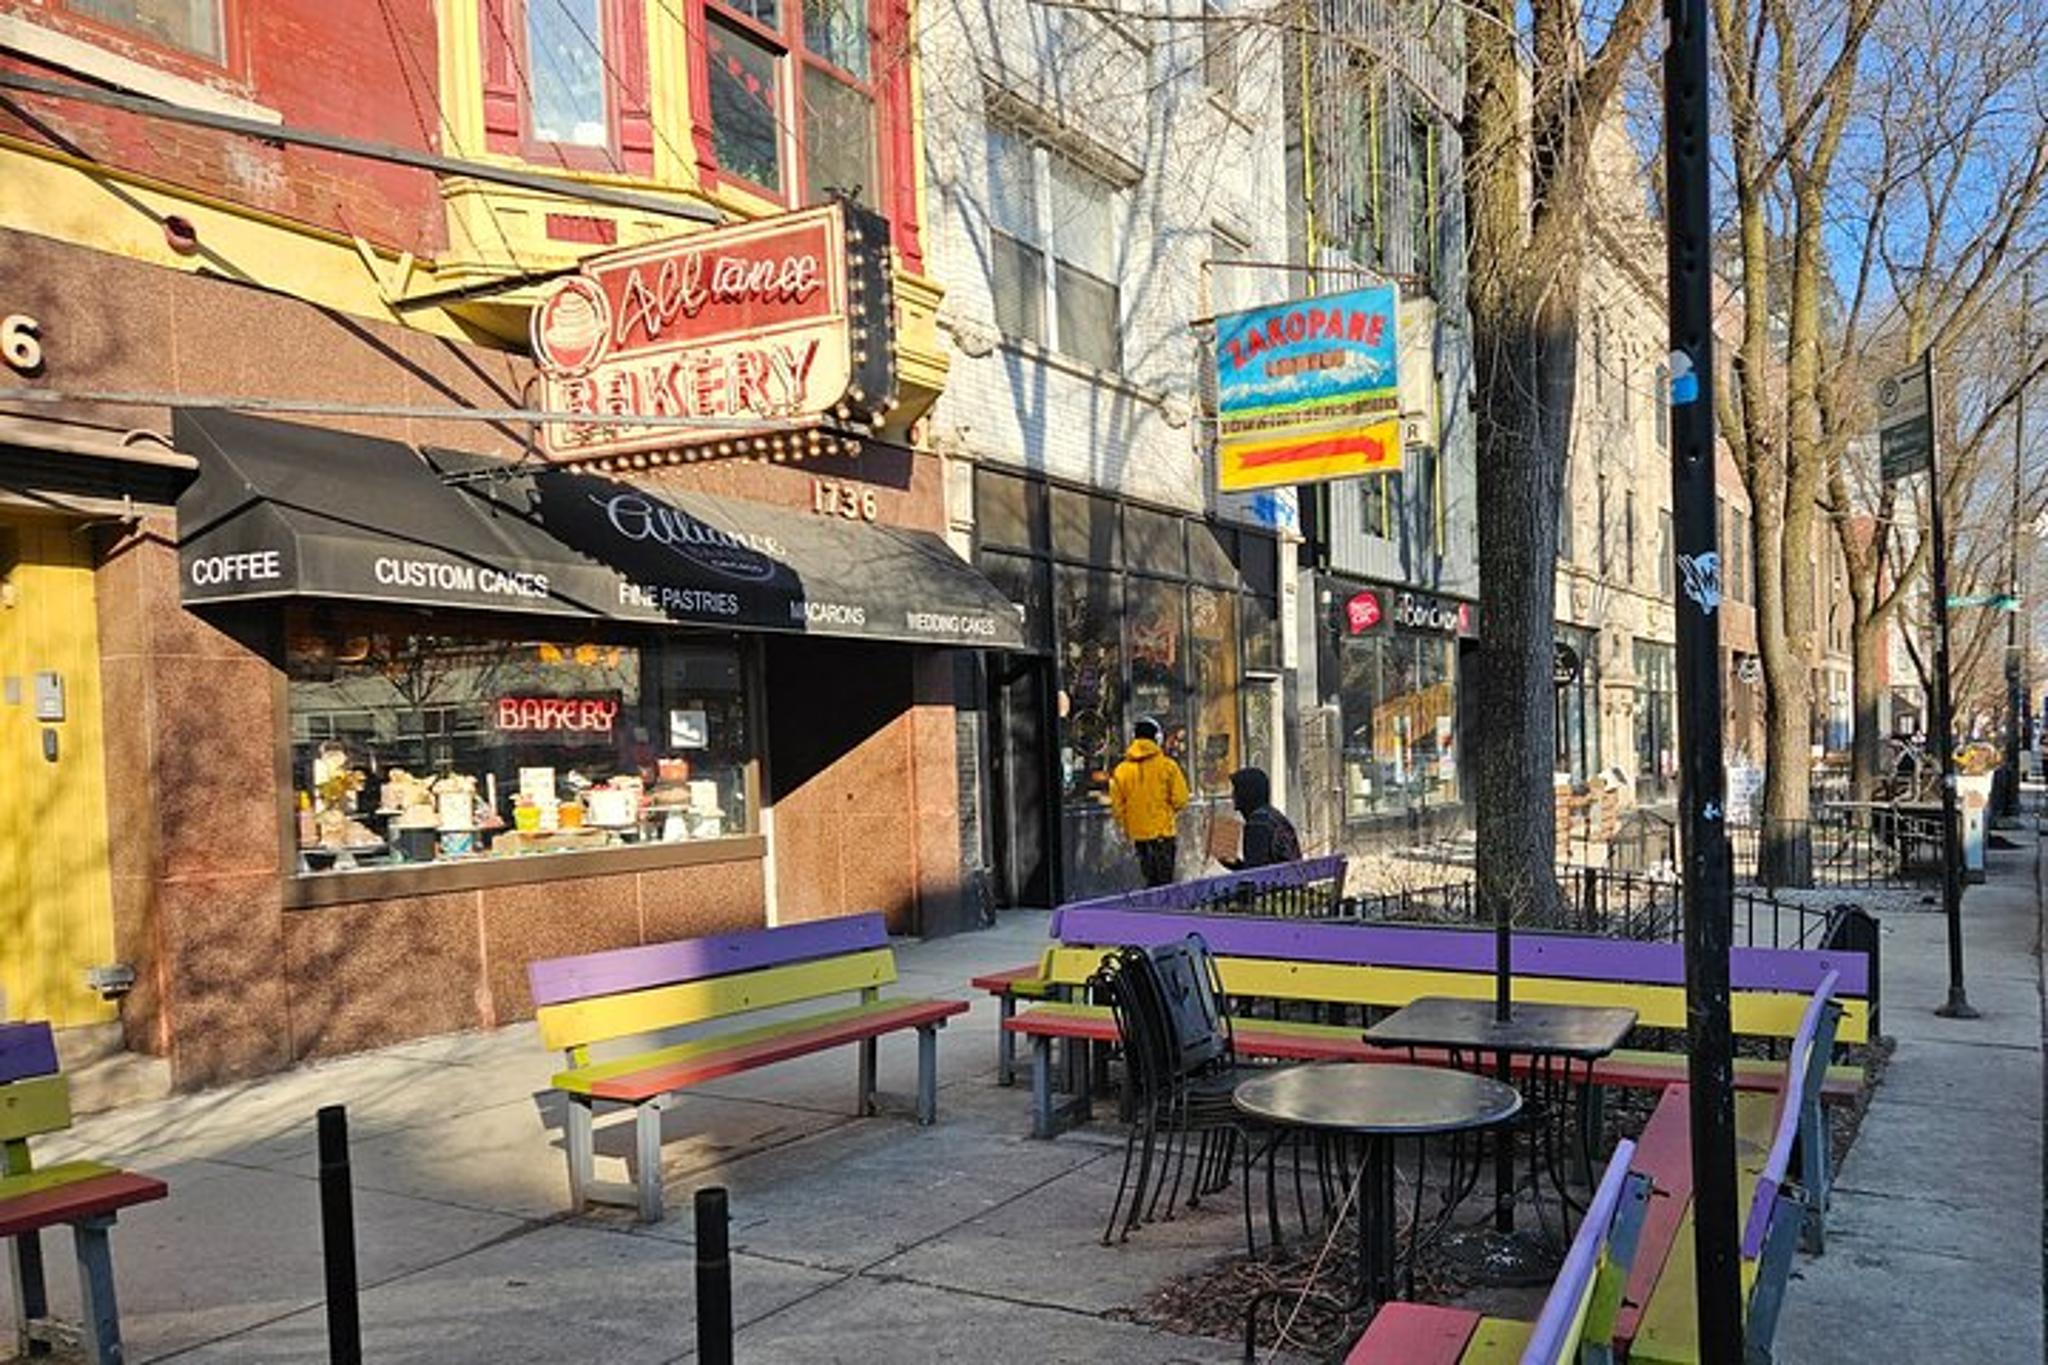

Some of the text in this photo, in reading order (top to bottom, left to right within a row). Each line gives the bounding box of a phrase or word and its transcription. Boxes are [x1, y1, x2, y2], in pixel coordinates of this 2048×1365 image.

[616, 249, 823, 344] Alliance
[560, 338, 820, 443] BAKERY
[813, 479, 877, 520] 1736
[191, 551, 282, 584] COFFEE
[374, 557, 551, 598] CUSTOM CAKES
[618, 582, 740, 615] FINE PASTRIES
[789, 601, 866, 626] MACARONS
[906, 612, 997, 635] WEDDING CAKES
[495, 697, 620, 732] BAKERY
